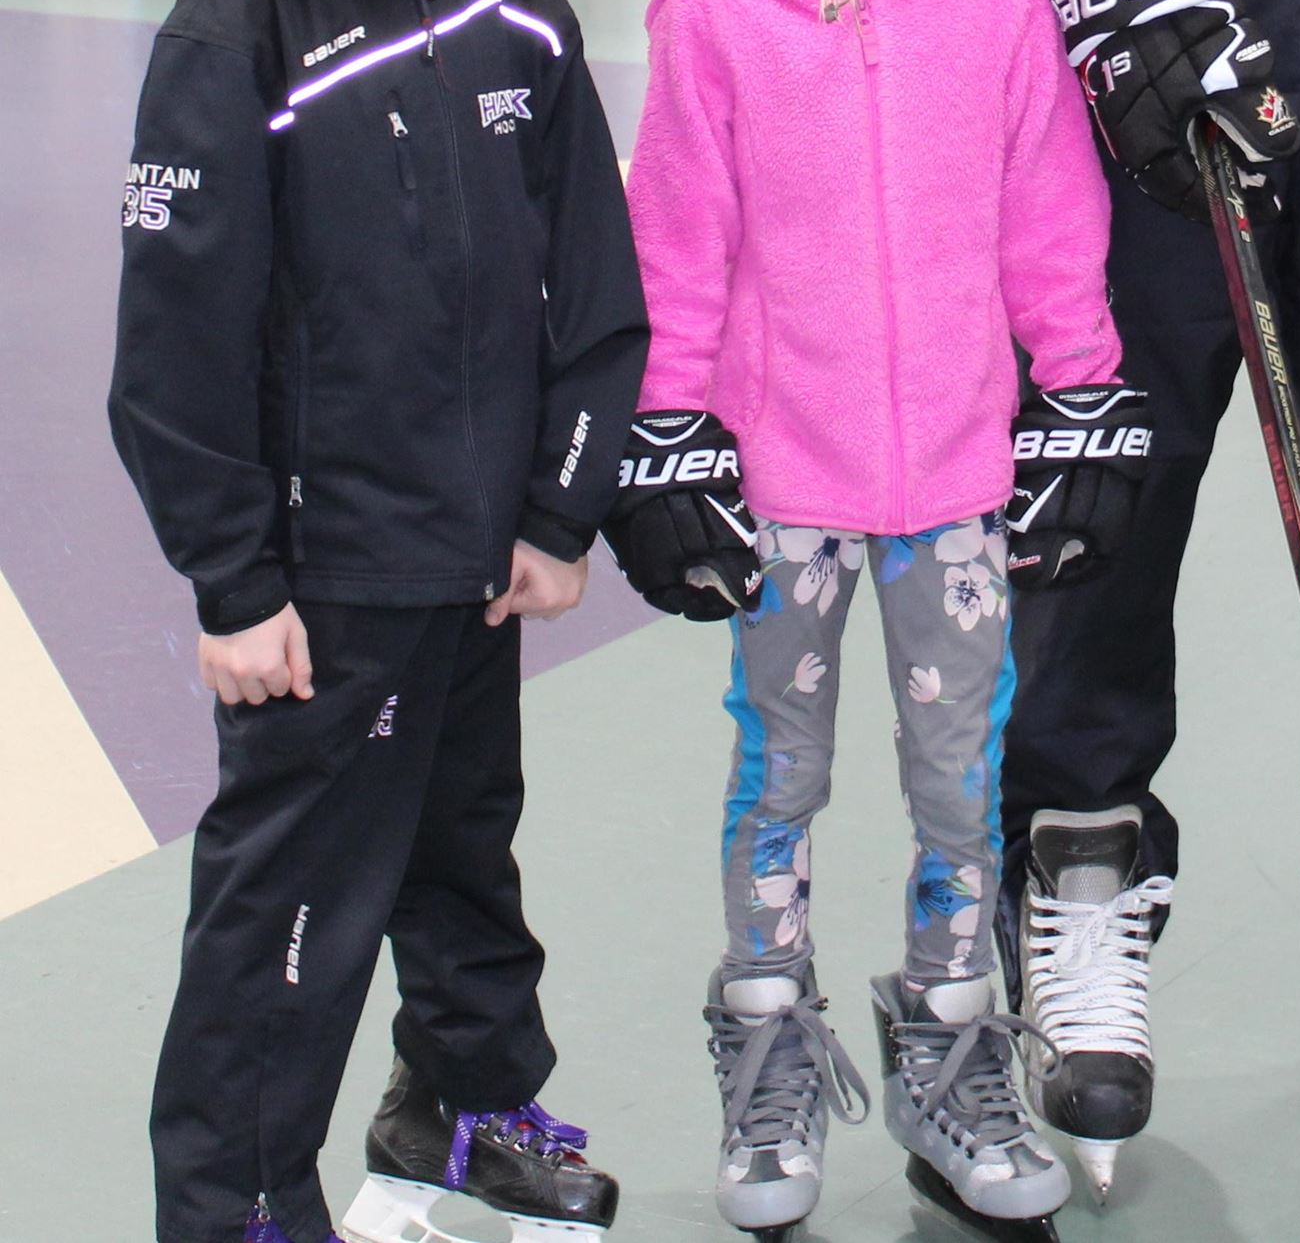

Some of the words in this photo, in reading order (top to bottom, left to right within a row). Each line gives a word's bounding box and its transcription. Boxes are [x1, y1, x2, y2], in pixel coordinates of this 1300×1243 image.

[303, 26, 367, 68] BAUER
[477, 88, 533, 129] HAK
[494, 118, 516, 136] HOC
[1254, 300, 1288, 386] BAUER
[559, 411, 592, 489] BAUER
[618, 449, 741, 488] AUER
[286, 904, 310, 985] BAUER
